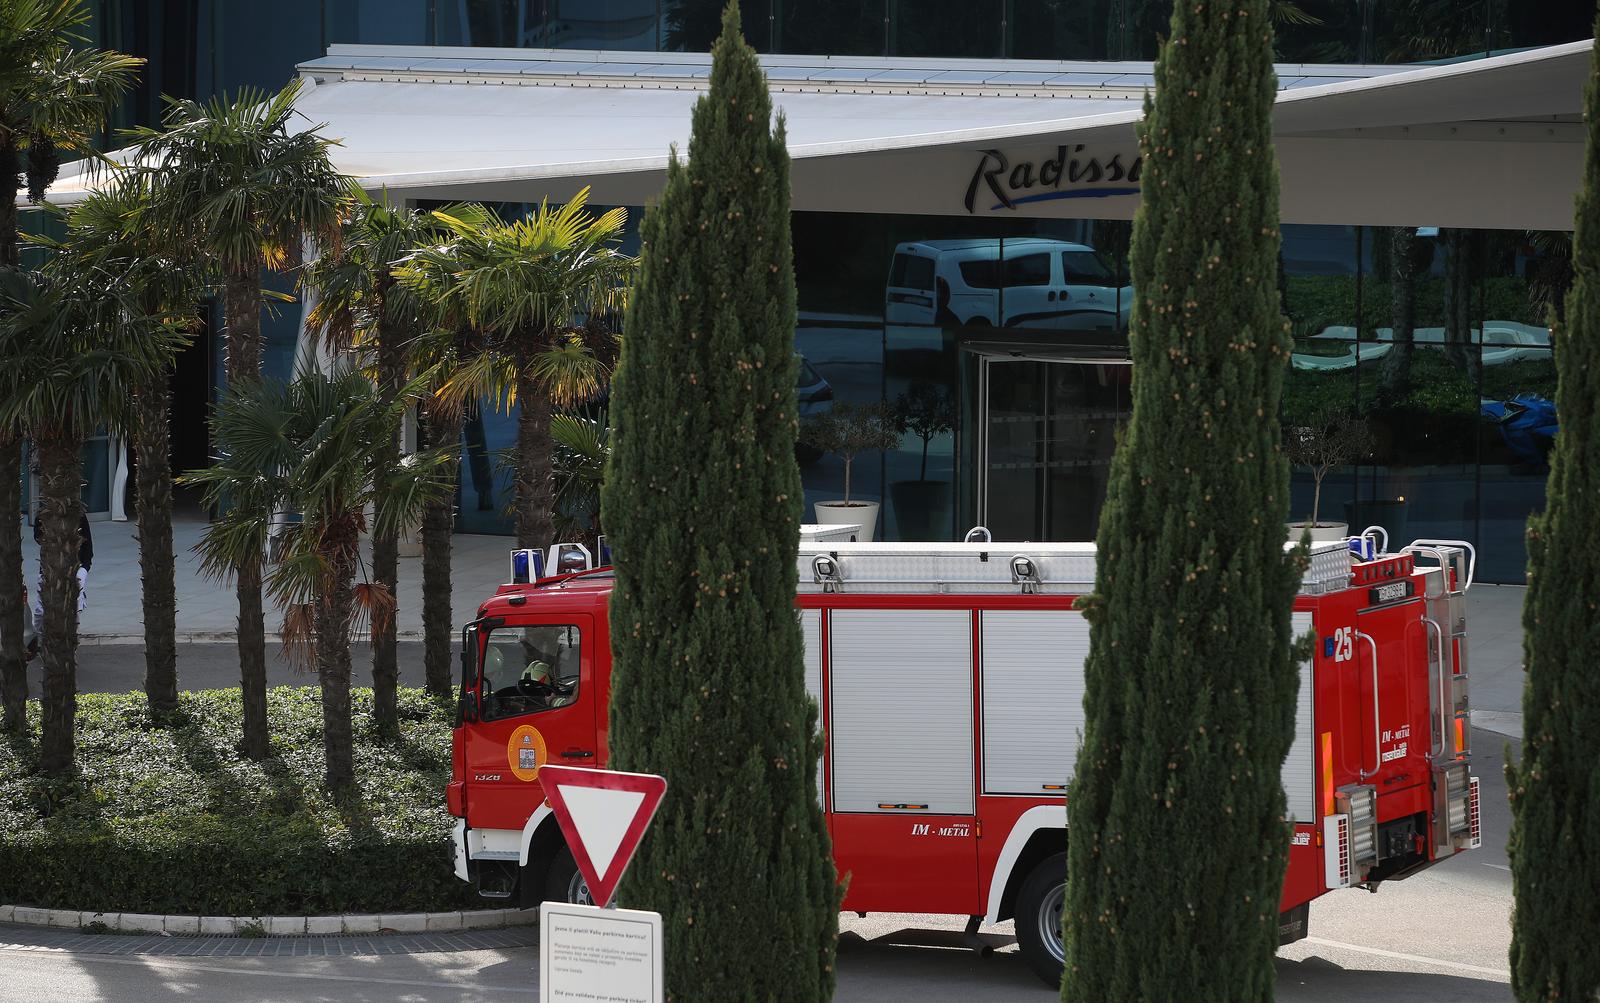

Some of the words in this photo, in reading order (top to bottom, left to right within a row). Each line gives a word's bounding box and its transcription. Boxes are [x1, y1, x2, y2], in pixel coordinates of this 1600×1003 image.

[1334, 626, 1353, 663] 25
[911, 823, 930, 836] IM
[938, 828, 970, 836] METAL
